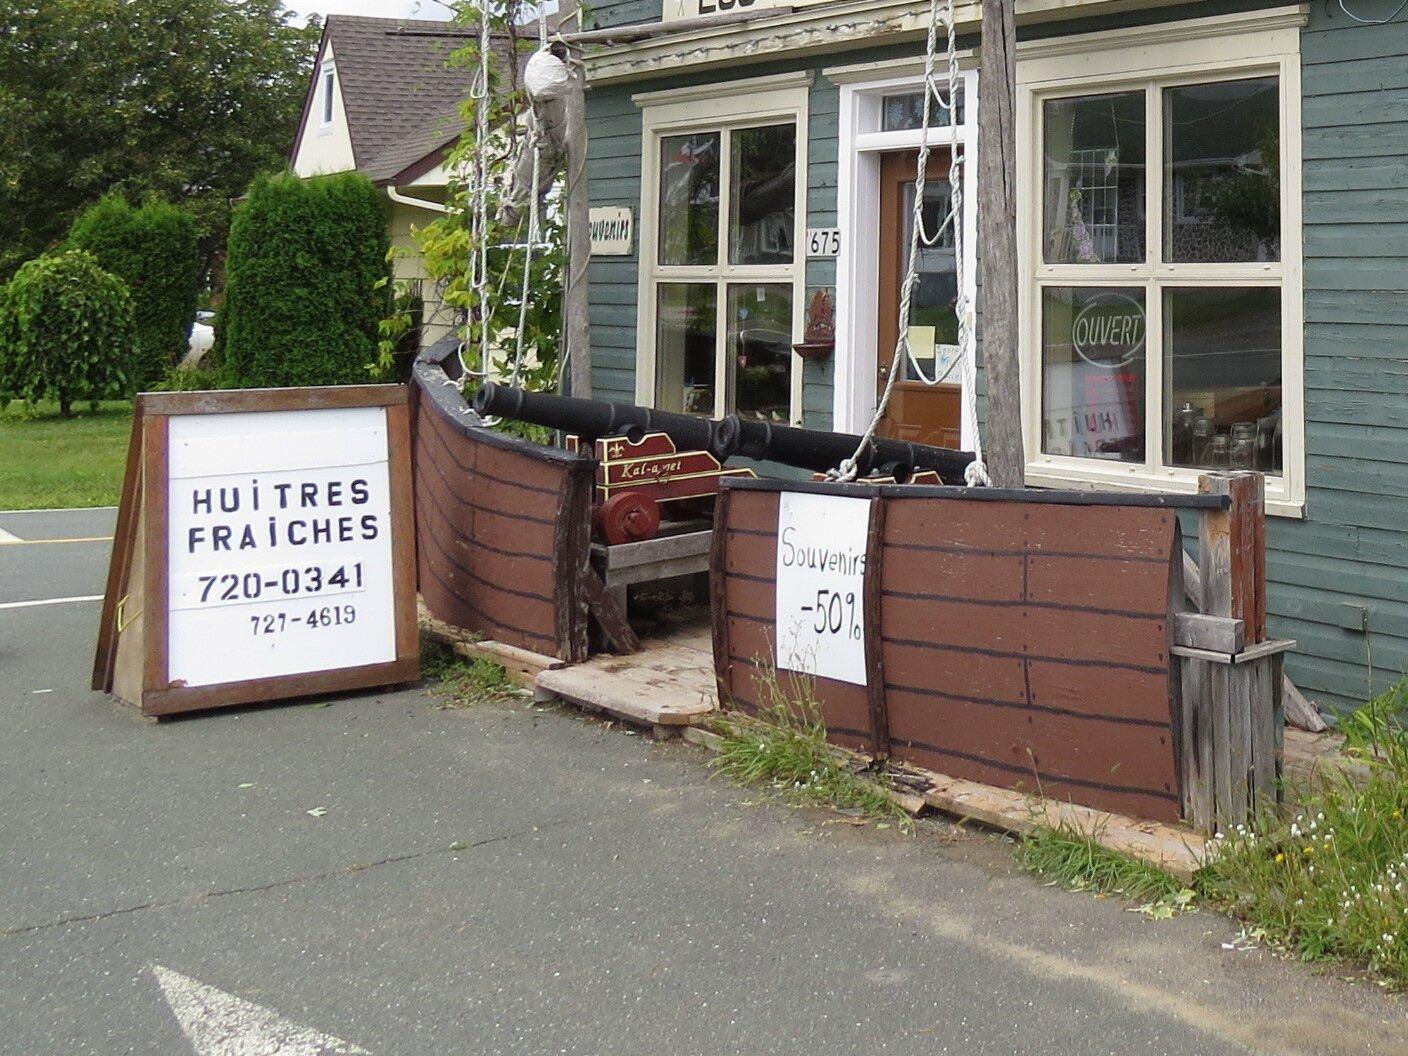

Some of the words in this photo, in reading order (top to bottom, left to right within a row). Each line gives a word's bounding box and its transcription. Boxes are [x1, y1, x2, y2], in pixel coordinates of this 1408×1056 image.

[811, 230, 840, 255] 675
[1076, 315, 1142, 346] OUVERT
[782, 526, 867, 576] Souvenirs
[198, 562, 363, 603] 720-0341
[250, 605, 357, 635] 727-4619
[800, 589, 861, 641] -50%
